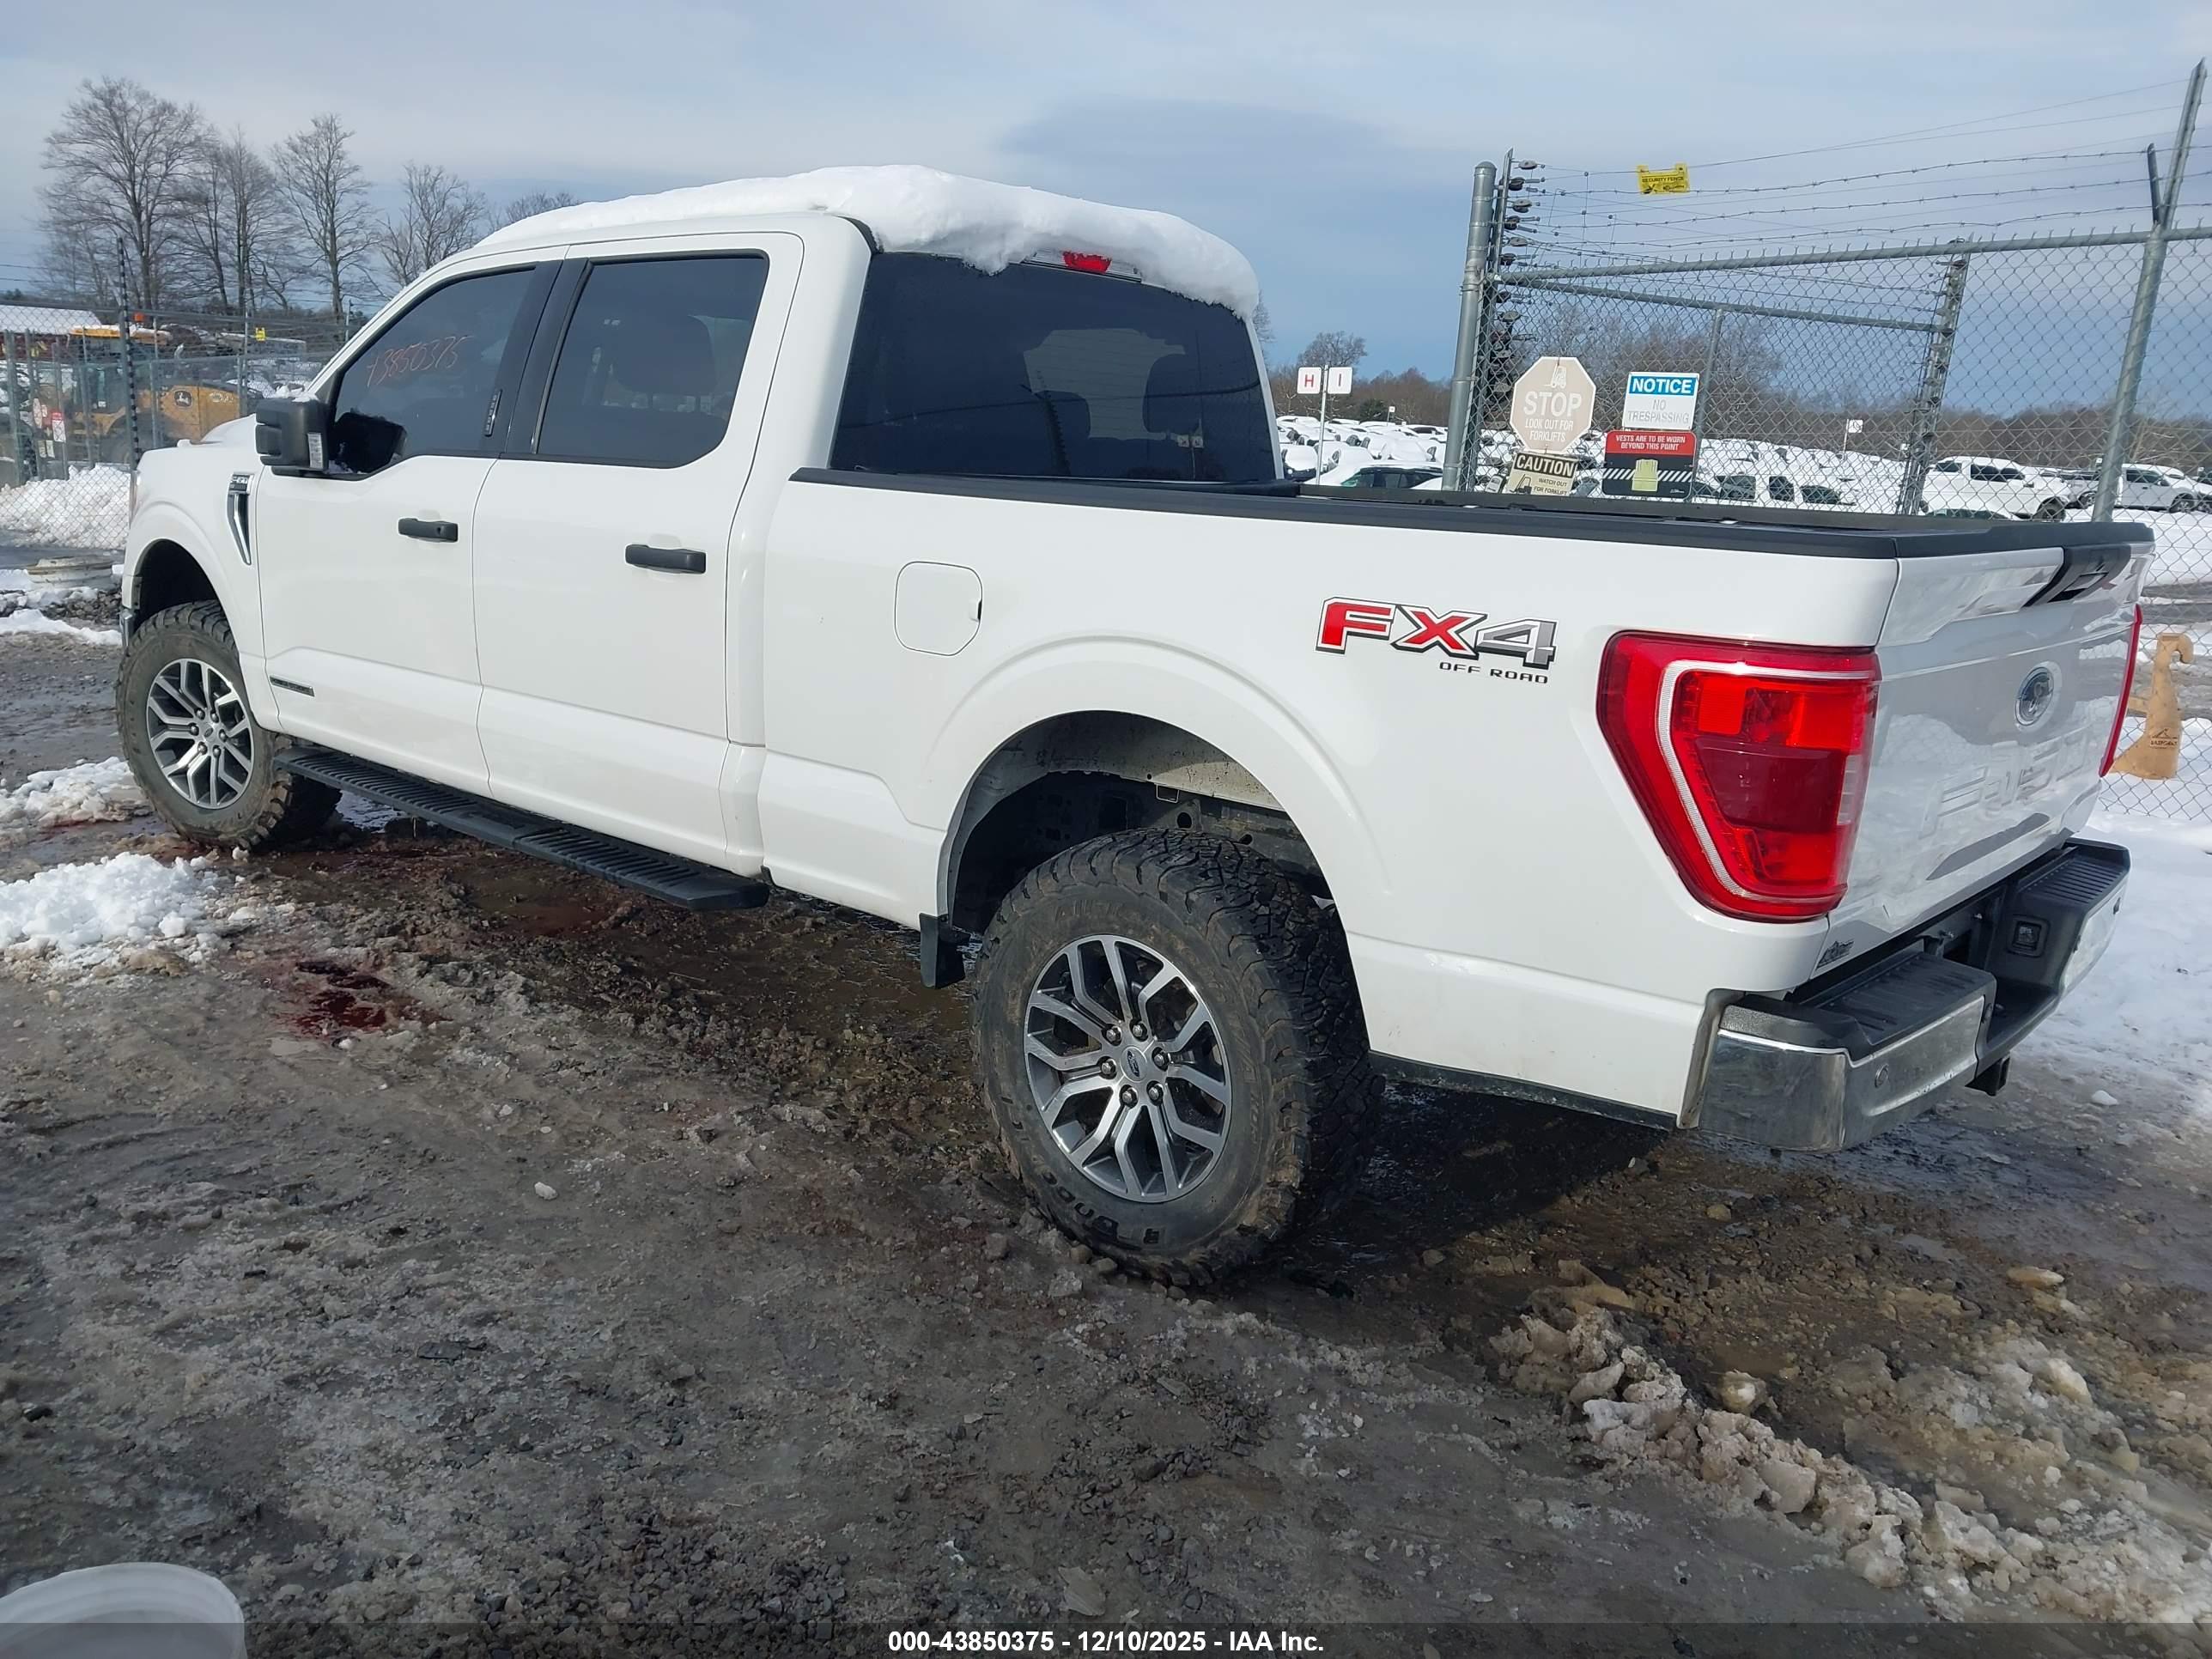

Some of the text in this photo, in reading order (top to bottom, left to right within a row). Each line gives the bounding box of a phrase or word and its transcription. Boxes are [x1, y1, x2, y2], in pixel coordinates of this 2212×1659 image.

[1304, 374, 1315, 387] H
[1632, 378, 1692, 393] NOTICE
[1523, 391, 1583, 416] STOP
[1652, 399, 1666, 410] NO
[1525, 418, 1574, 430] LOOK OUT FOR
[1628, 410, 1690, 424] TRESPASSING
[1529, 430, 1566, 442] FORKLIFTS
[1516, 454, 1575, 477] CAUTION
[1315, 596, 1558, 670] FX4
[1439, 661, 1548, 684] OFF ROAD
